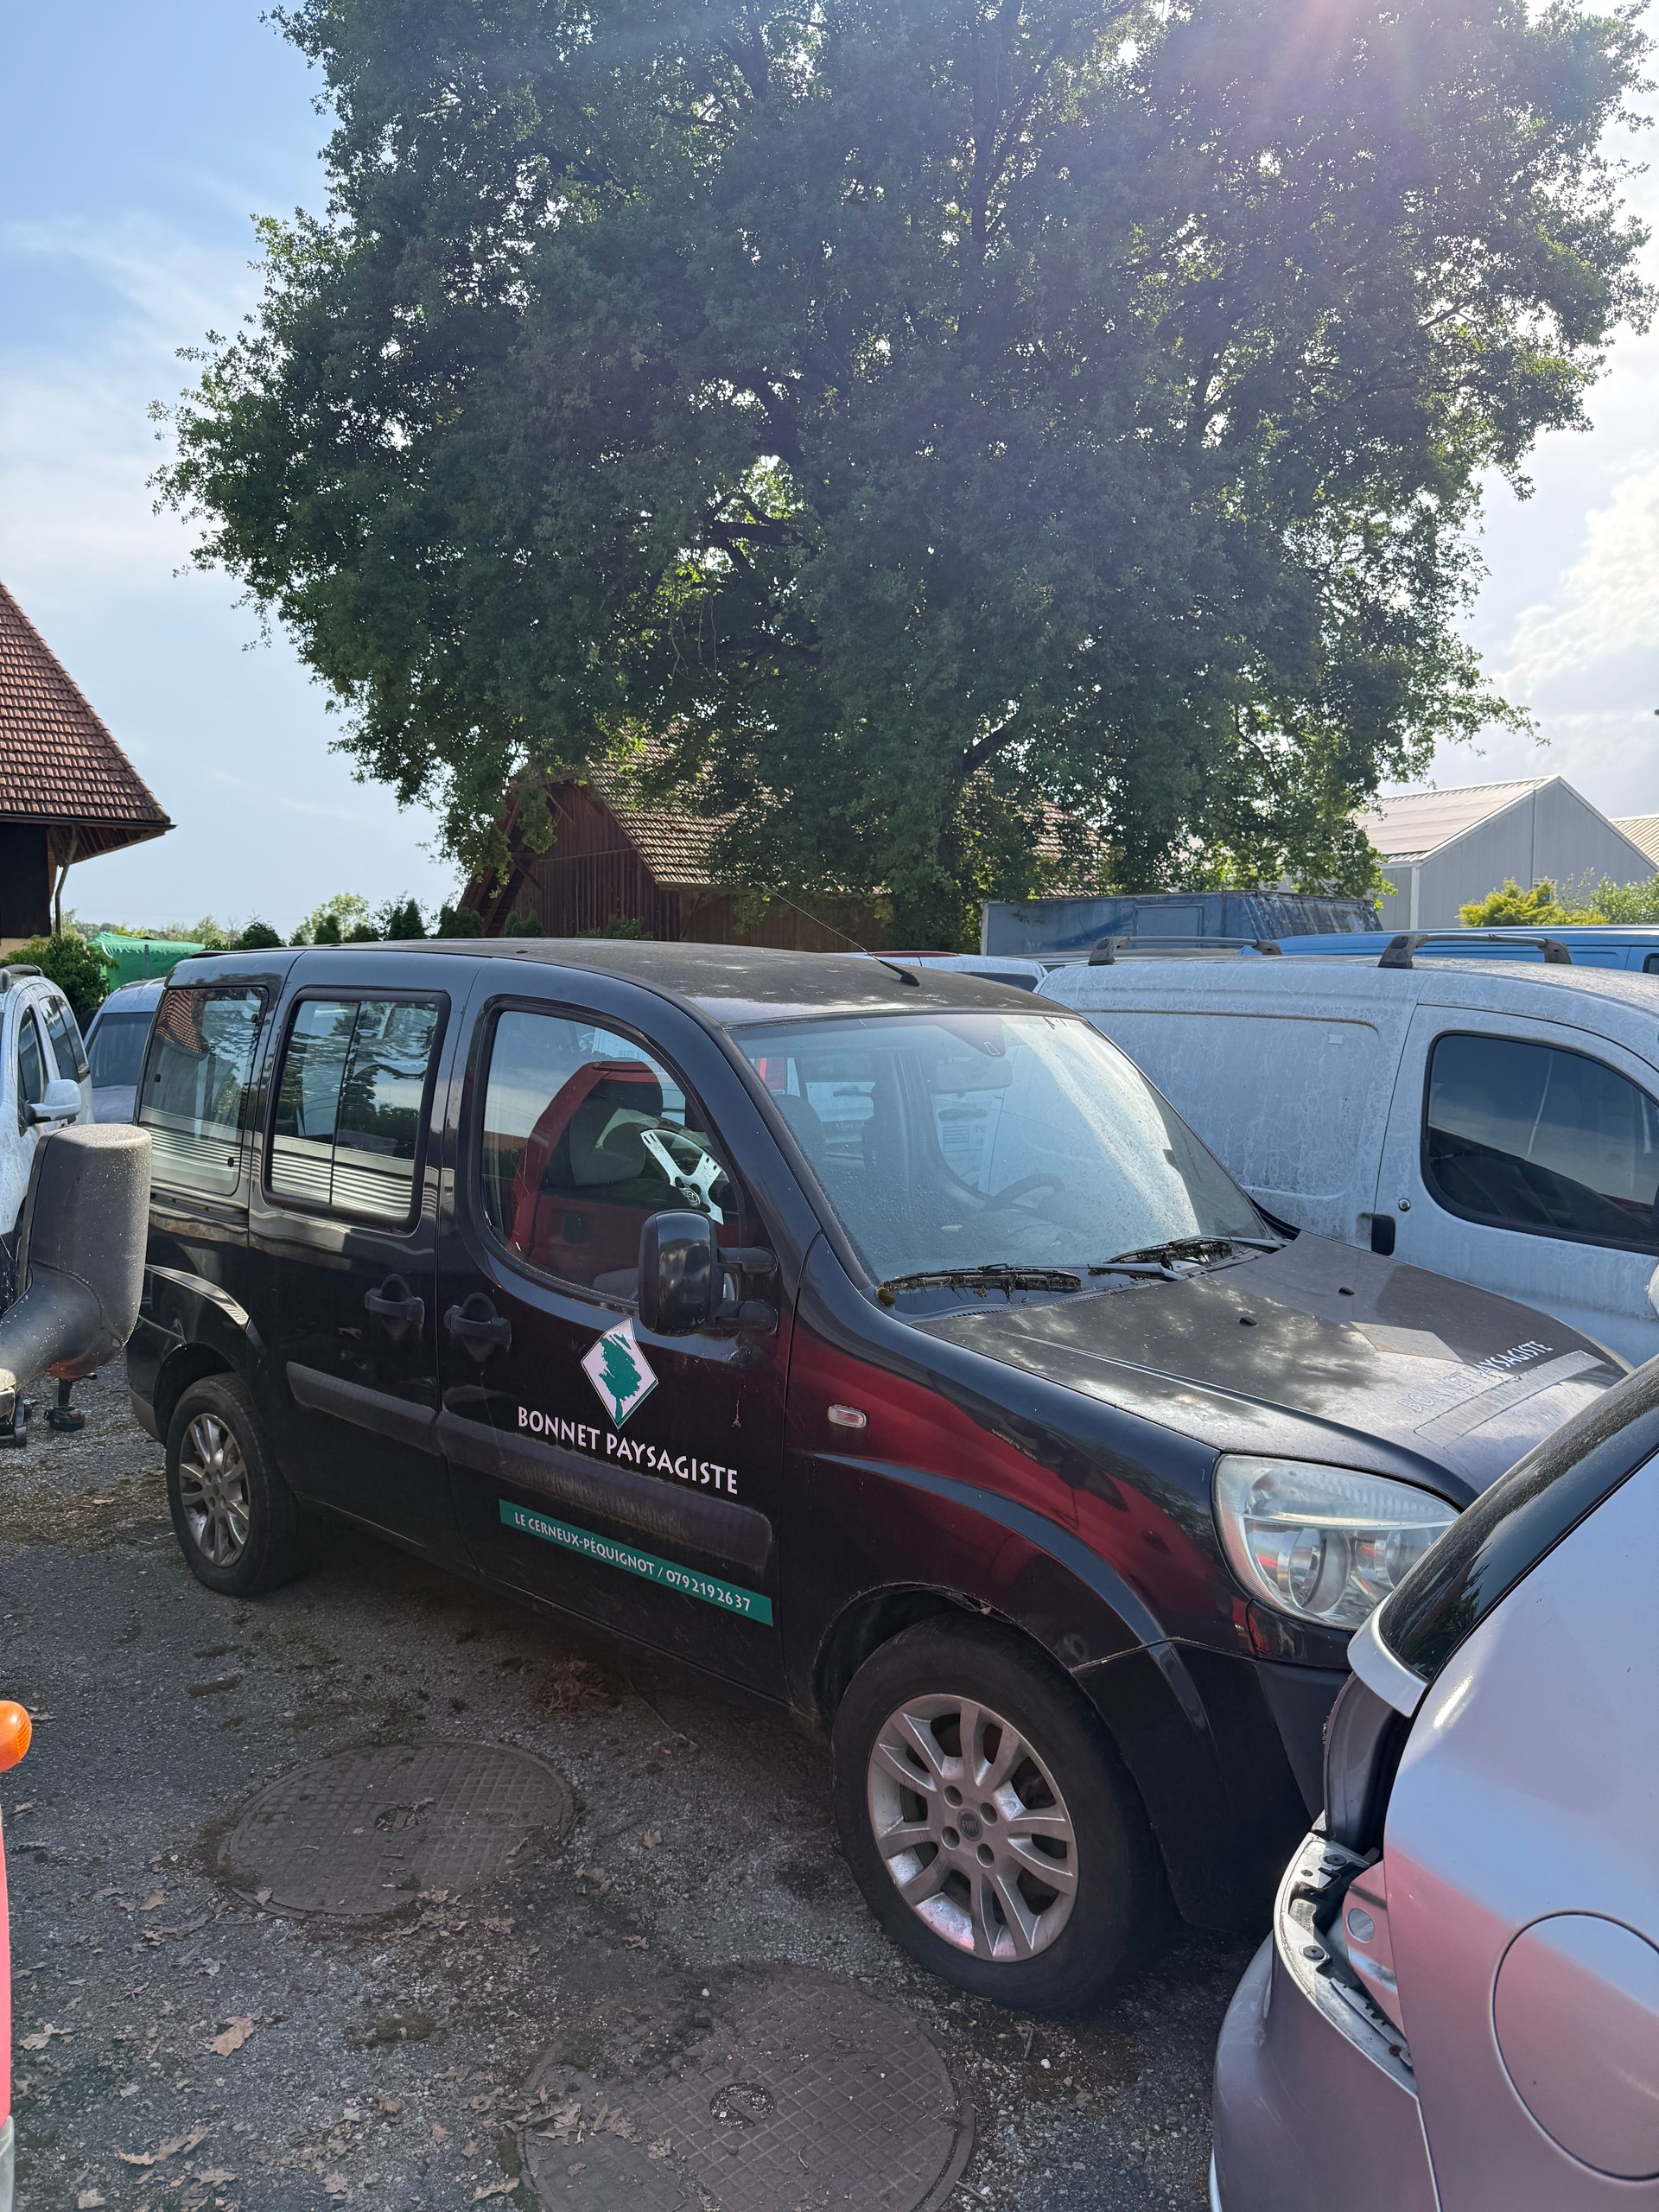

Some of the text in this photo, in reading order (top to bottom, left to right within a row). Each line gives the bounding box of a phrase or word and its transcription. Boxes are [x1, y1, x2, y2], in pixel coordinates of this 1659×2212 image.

[518, 1405, 738, 1495] BONNET PAYSAGISTE
[514, 1511, 526, 1527] LE
[528, 1517, 655, 1576] CERNEUX-PÉQUIGNOT
[961, 1820, 979, 1833] FIAT
